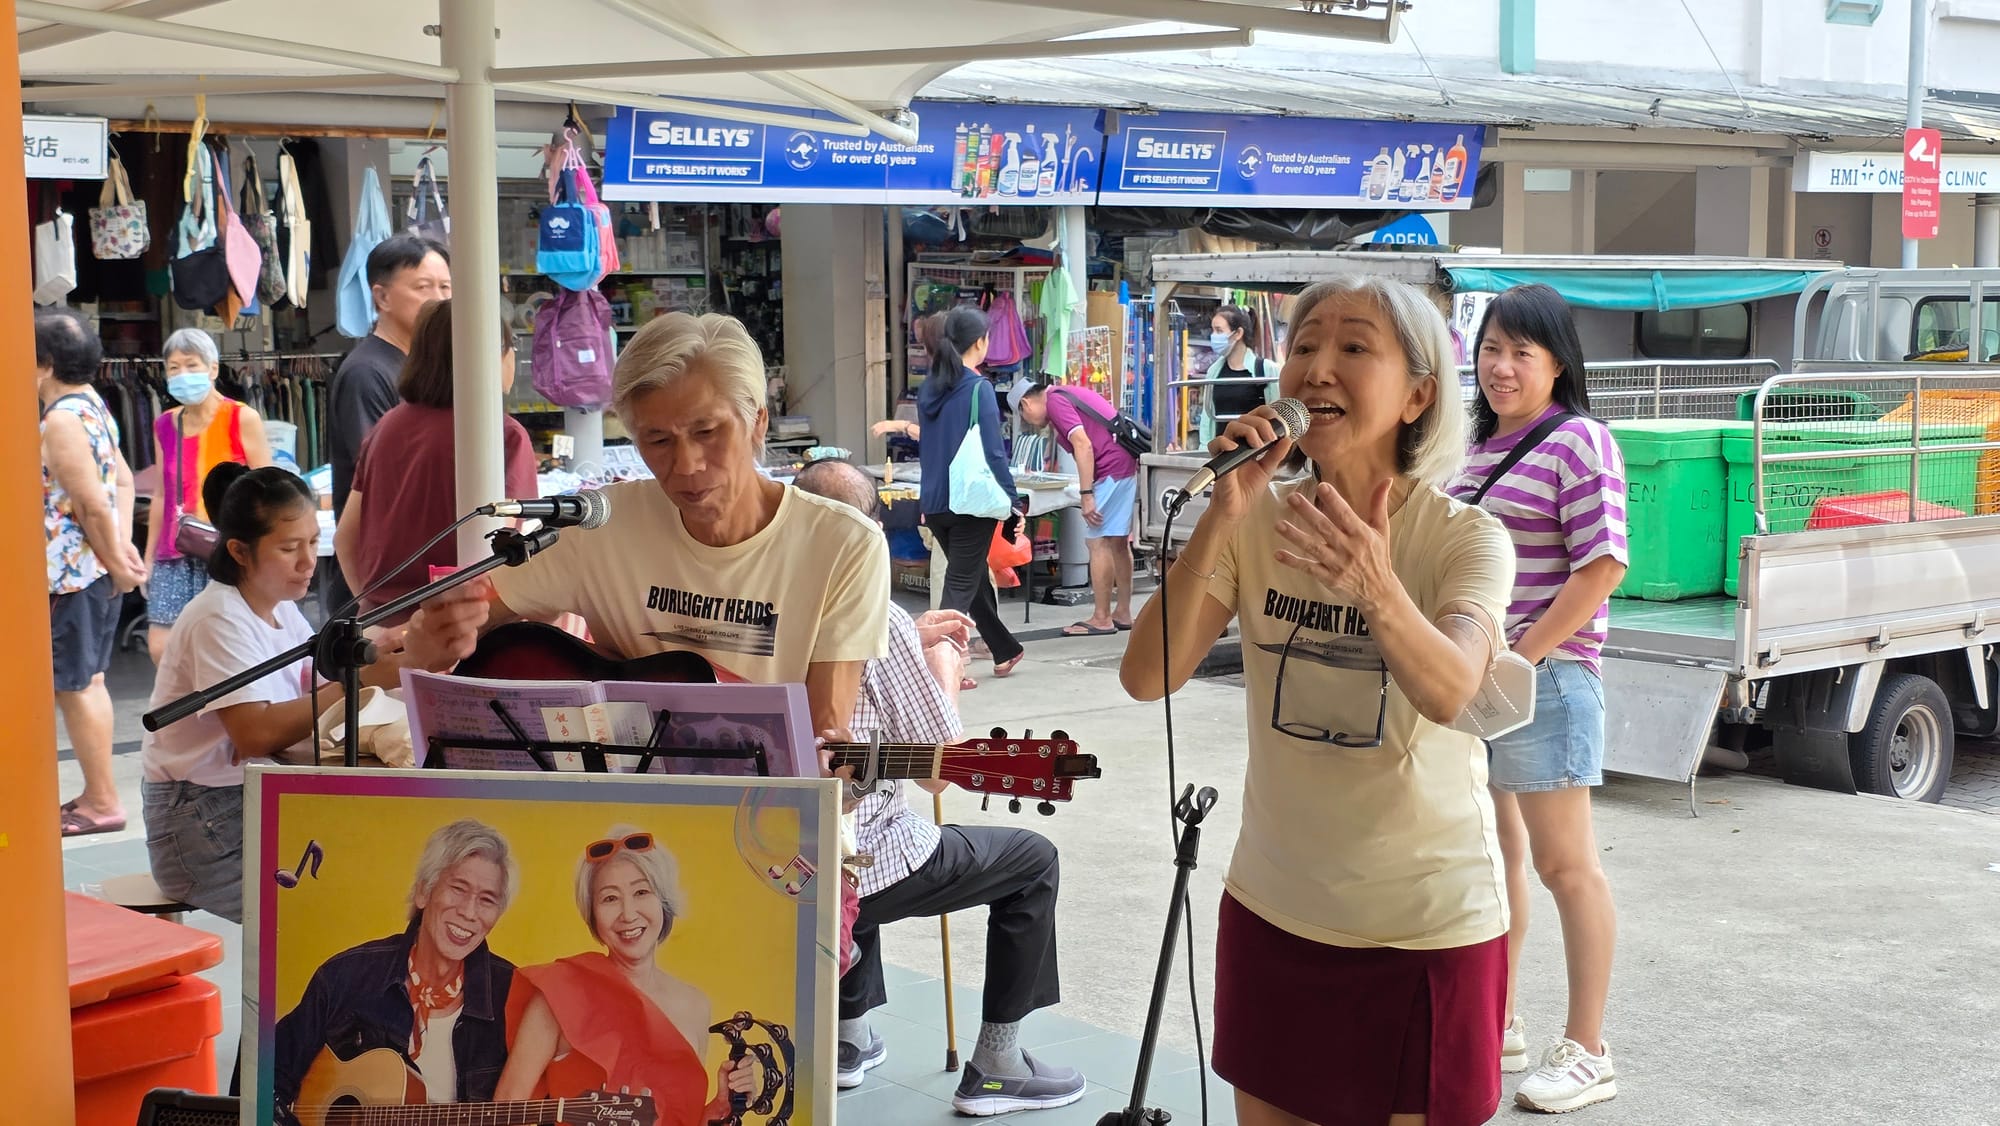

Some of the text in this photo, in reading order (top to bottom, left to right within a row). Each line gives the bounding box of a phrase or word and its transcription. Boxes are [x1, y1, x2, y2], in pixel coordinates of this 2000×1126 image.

[648, 121, 750, 147] SELLEYS
[822, 139, 935, 153] Trusted by Australians
[1136, 137, 1212, 159] SELLEYS
[832, 153, 917, 167] for over 80 years
[1266, 152, 1351, 164] Trusted by Australians
[646, 164, 655, 174] IF
[672, 165, 706, 175] SELLEYS
[1272, 164, 1337, 176] for over 80 years
[1830, 168, 1859, 186] HMI
[1945, 170, 1988, 187] CLINIC
[1382, 233, 1428, 245] OPEN
[646, 585, 774, 627] BURLEIGHT HEADS
